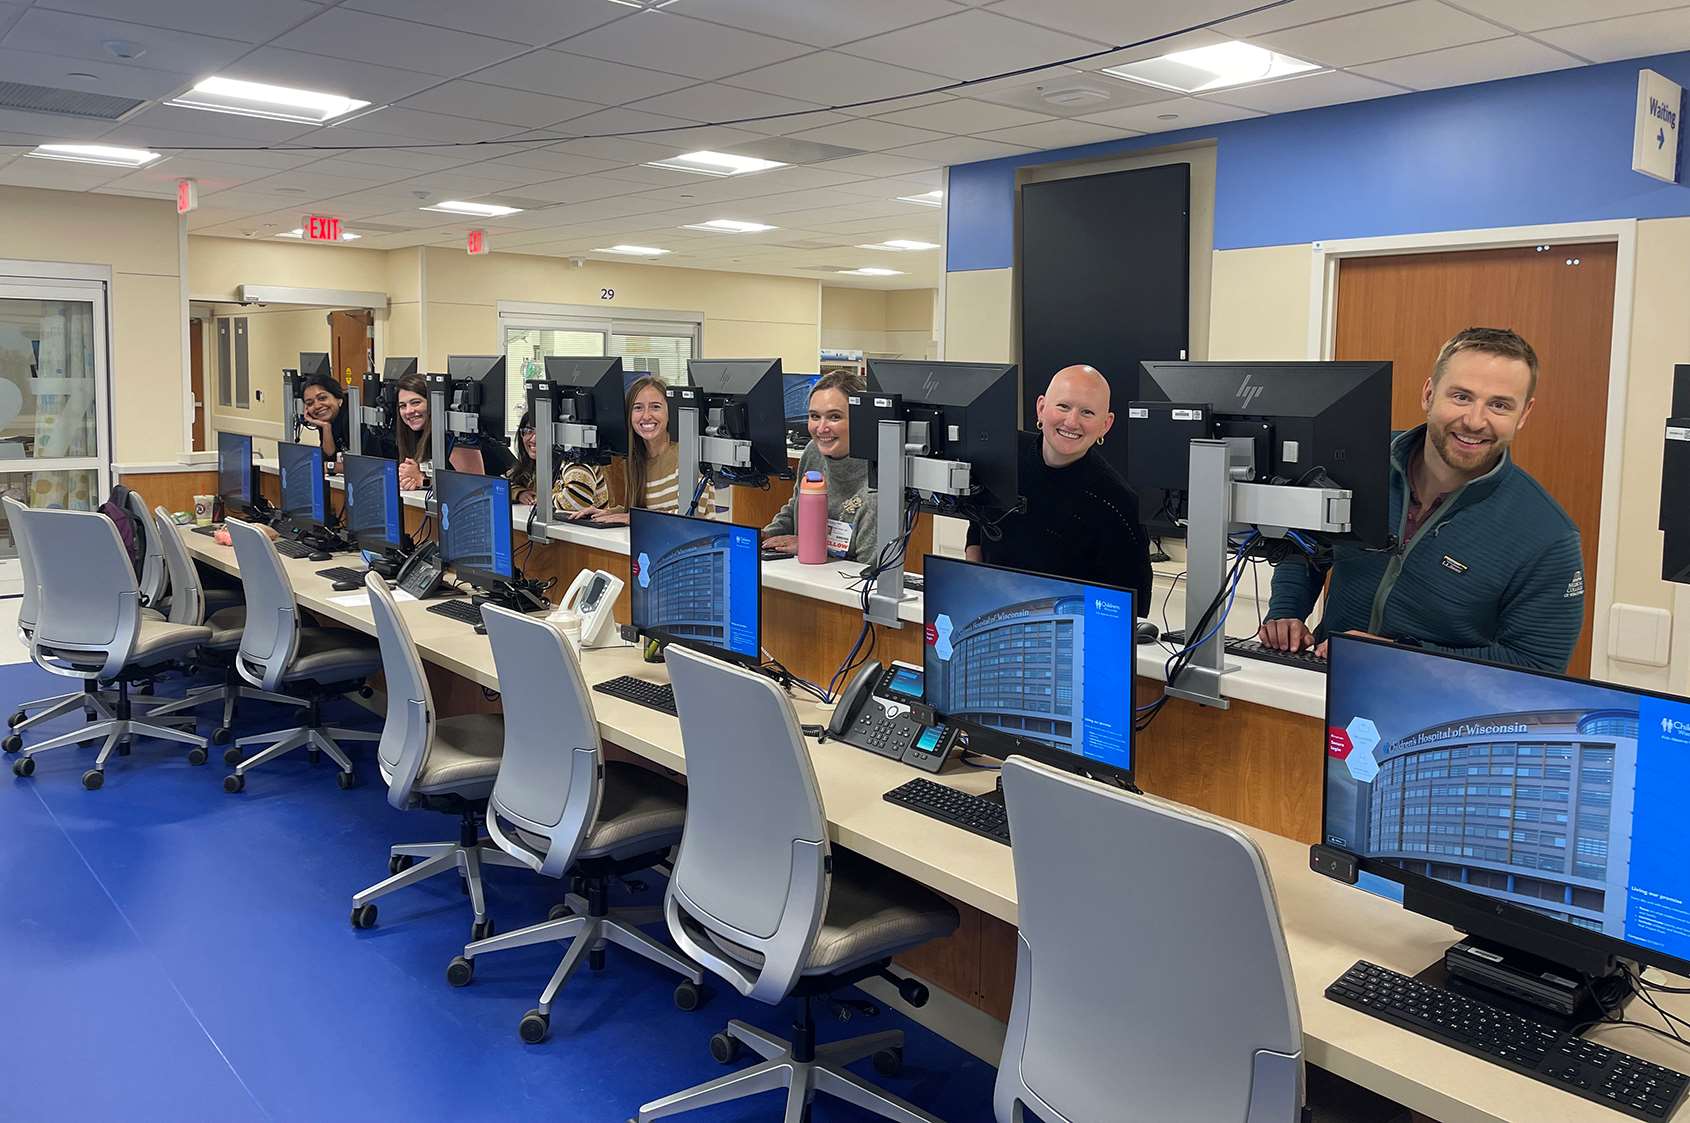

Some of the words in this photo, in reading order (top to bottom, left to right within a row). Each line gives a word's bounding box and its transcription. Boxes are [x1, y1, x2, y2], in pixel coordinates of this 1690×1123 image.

[1649, 96, 1676, 129] Waiting
[310, 217, 339, 240] EXIT
[601, 288, 614, 300] 29
[1236, 374, 1264, 409] hp
[1418, 727, 1451, 745] Hospital
[1453, 725, 1463, 737] of
[1465, 721, 1528, 736] Wisconsin
